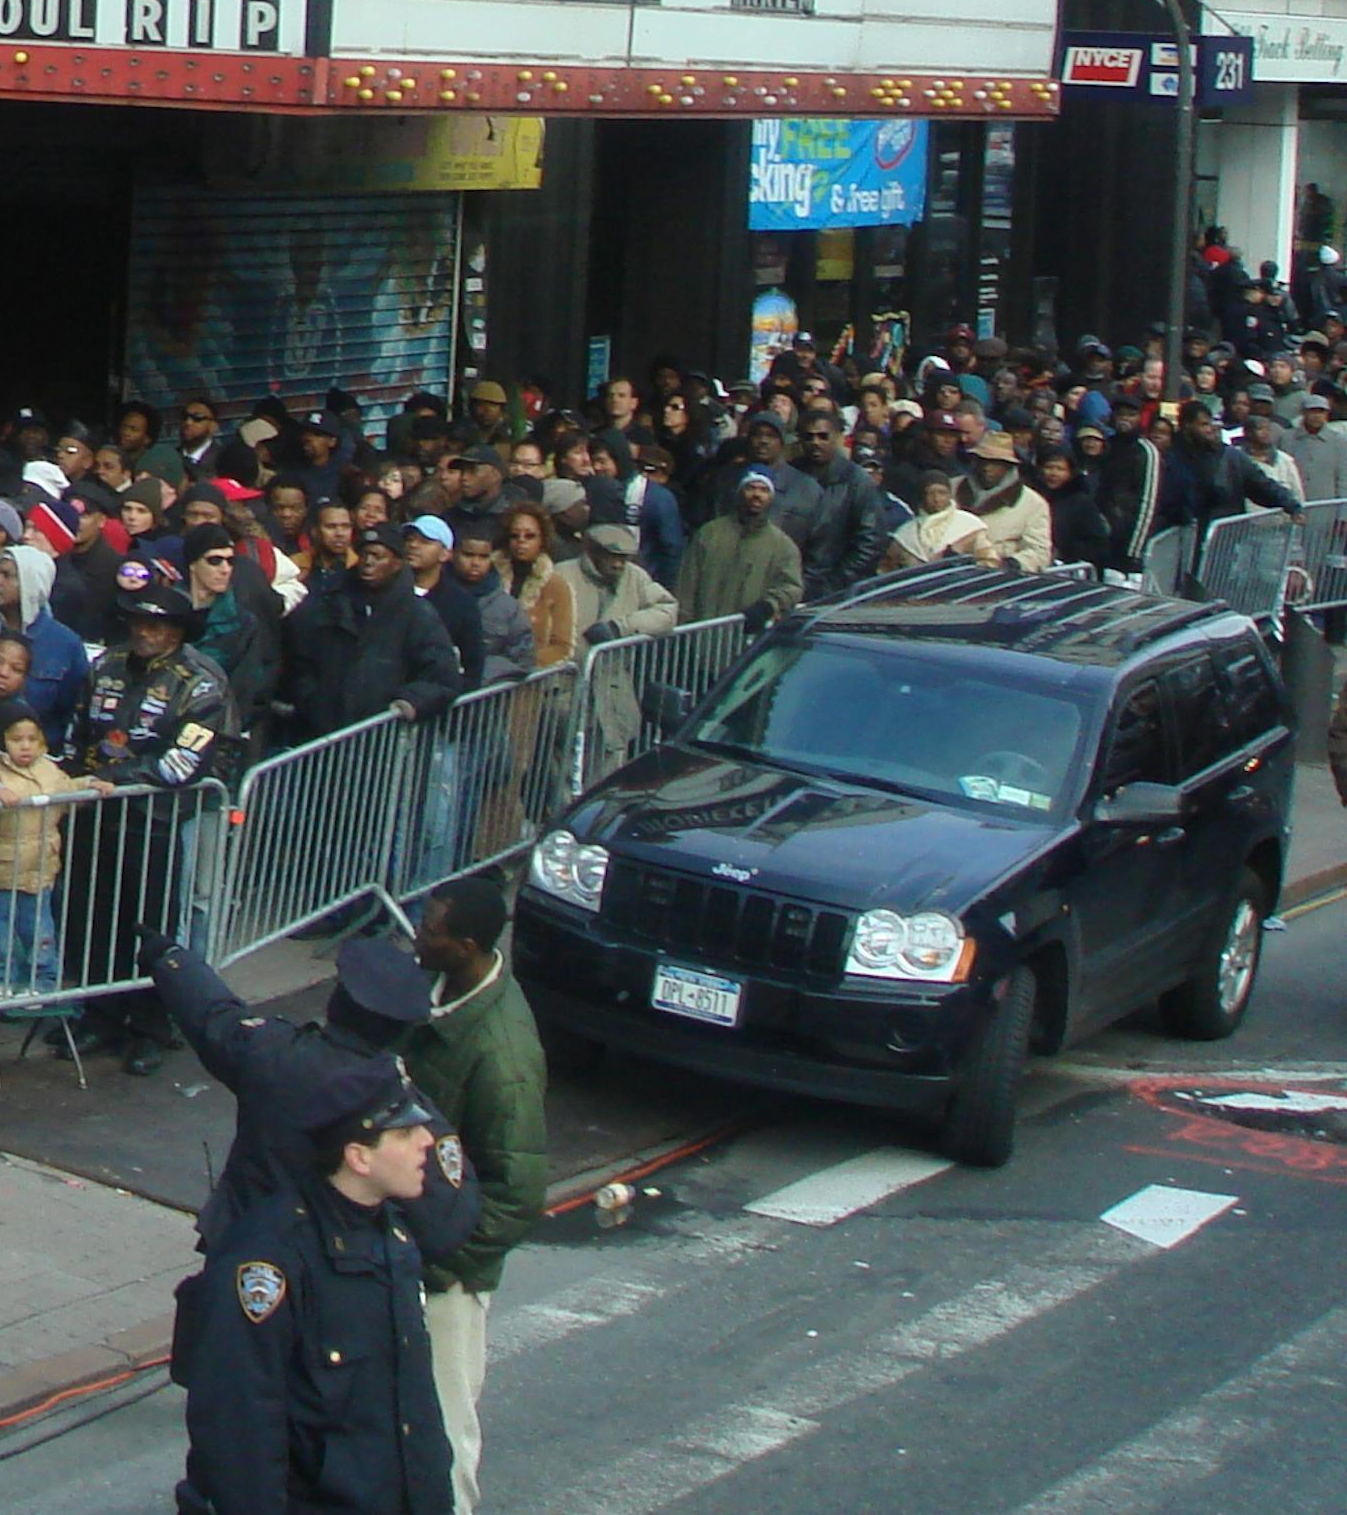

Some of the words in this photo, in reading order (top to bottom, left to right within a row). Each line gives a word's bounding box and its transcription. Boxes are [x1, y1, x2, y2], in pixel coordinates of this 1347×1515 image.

[1074, 49, 1131, 68] NYCE
[1215, 52, 1244, 90] 231
[711, 862, 752, 882] Jeep
